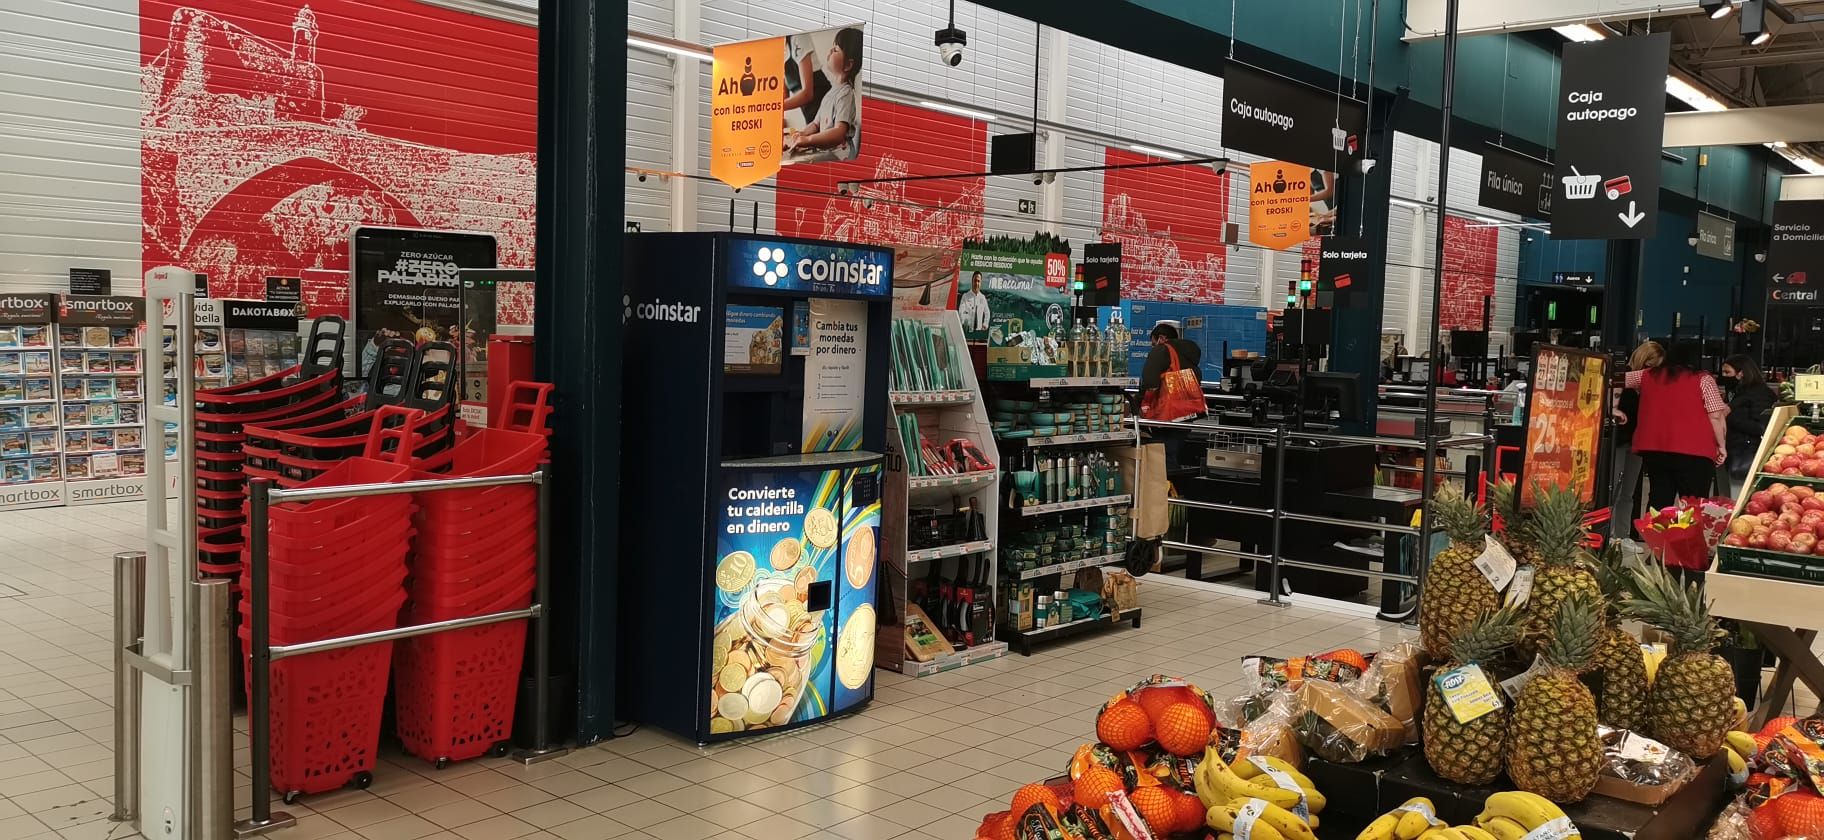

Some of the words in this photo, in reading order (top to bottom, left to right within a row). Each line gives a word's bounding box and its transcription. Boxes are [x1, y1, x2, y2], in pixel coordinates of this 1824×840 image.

[1568, 90, 1603, 104] Caja
[714, 106, 730, 116] con
[733, 103, 745, 114] las
[748, 102, 781, 112] marcas
[1230, 97, 1252, 117] Caja
[1253, 105, 1294, 129] autopago
[1567, 106, 1637, 121] autopago
[731, 118, 762, 131] EROSKI
[1487, 170, 1501, 190] Fila
[1503, 174, 1523, 195] única
[1266, 207, 1293, 215] EROSKI
[1322, 250, 1339, 259] Solo
[1340, 251, 1367, 260] tarjeta
[395, 259, 458, 275] #ZERO
[797, 253, 883, 285] coinstar
[1047, 259, 1066, 276] 50%
[1772, 289, 1817, 300] Central
[0, 297, 43, 309] rtbox
[66, 299, 134, 311] smartbox
[636, 298, 701, 323] coinstar
[195, 314, 220, 323] bella
[816, 321, 845, 331] Cambia
[846, 322, 858, 331] tus
[820, 333, 854, 343] monedas
[816, 347, 830, 356] por
[831, 344, 856, 354] dinero
[72, 484, 143, 499] smartbox
[728, 487, 795, 500] Convierte
[727, 505, 743, 516] tu
[746, 503, 804, 516] calderilla
[727, 523, 744, 534] en
[747, 520, 790, 533] dinero
